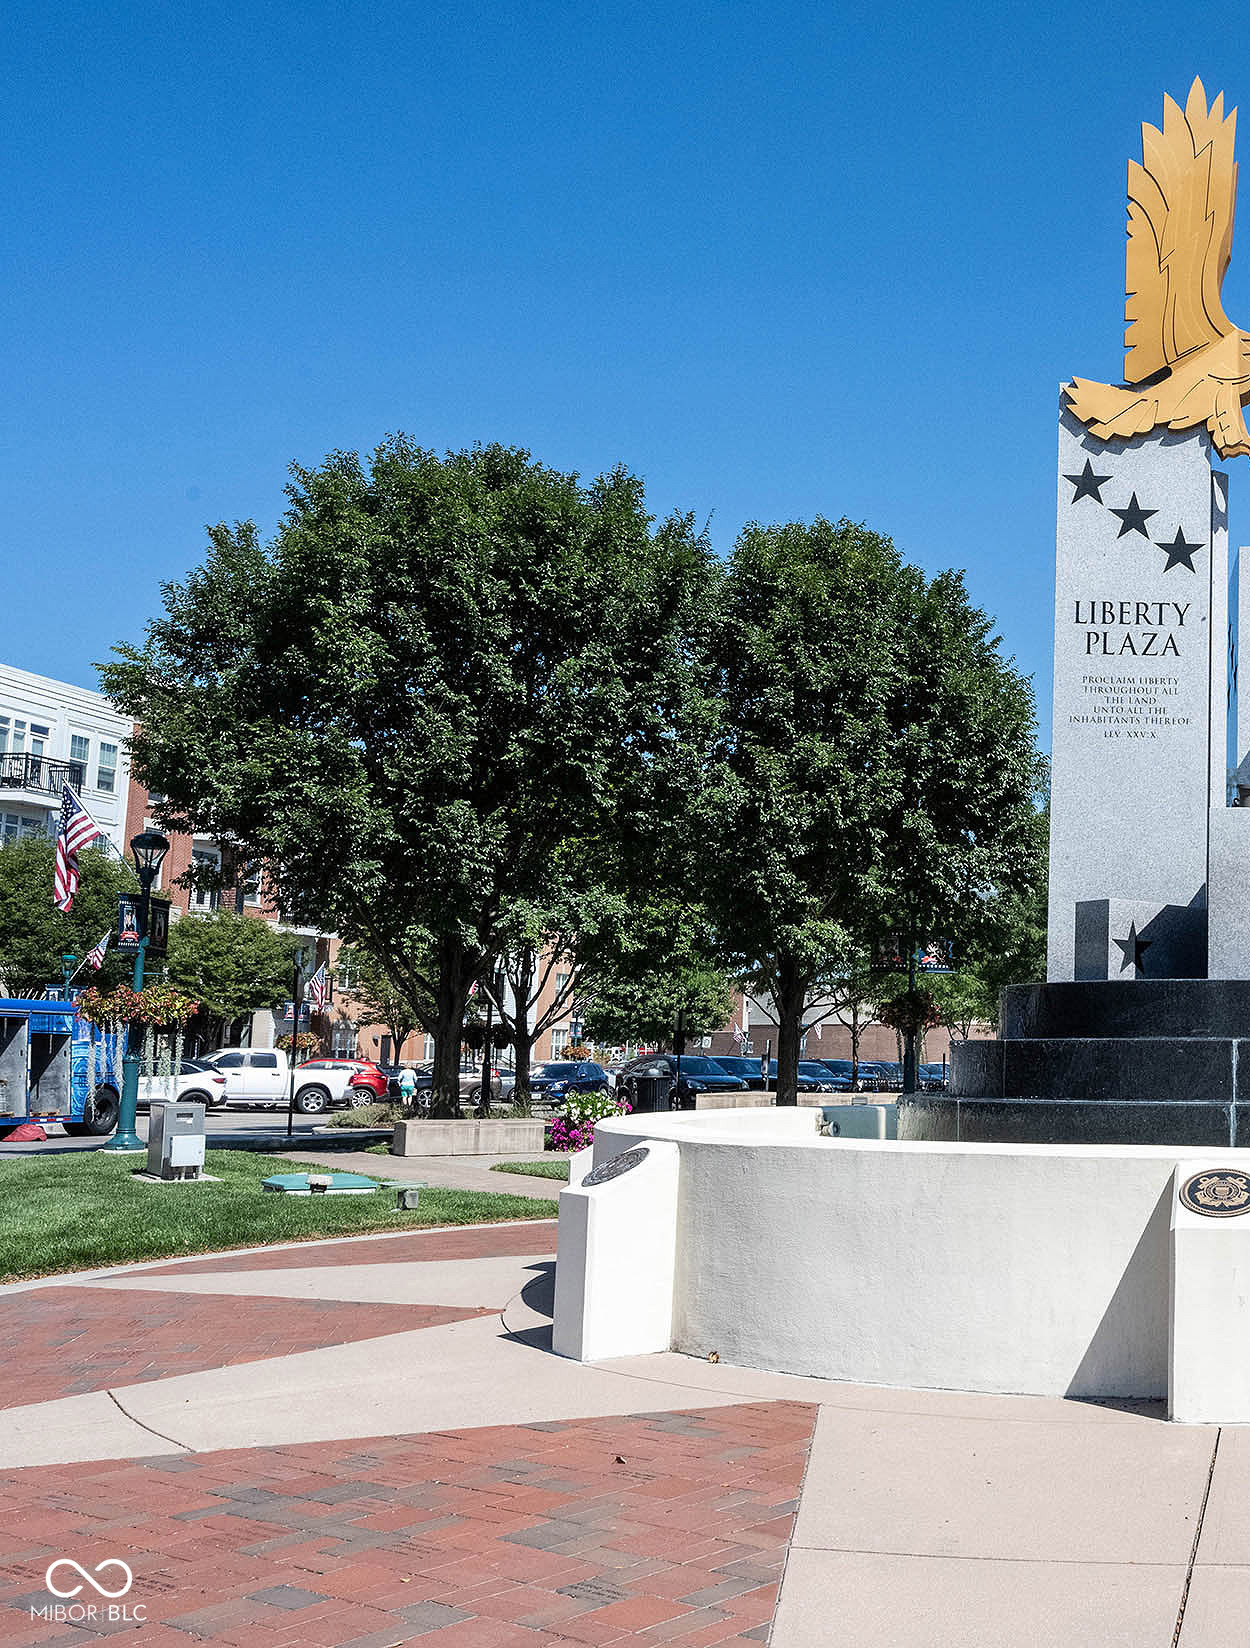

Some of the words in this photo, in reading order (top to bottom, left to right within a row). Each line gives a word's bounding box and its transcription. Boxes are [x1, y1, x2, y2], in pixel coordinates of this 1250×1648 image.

[1074, 600, 1191, 626] LIBERTY
[1085, 631, 1181, 657] PLAZA
[1082, 676, 1136, 685] PROCLAIM
[1139, 677, 1179, 686] LIBERTY
[1083, 686, 1159, 695] THROUGHOUT
[1161, 687, 1179, 696] ALL
[1104, 696, 1125, 704] THE
[1128, 697, 1157, 705] LAND
[1093, 706, 1124, 714] UNTO
[1127, 707, 1144, 715] ALL
[1147, 707, 1168, 715] THE
[1069, 715, 1141, 724] INHABITANTS
[1144, 717, 1192, 726] THEREOF
